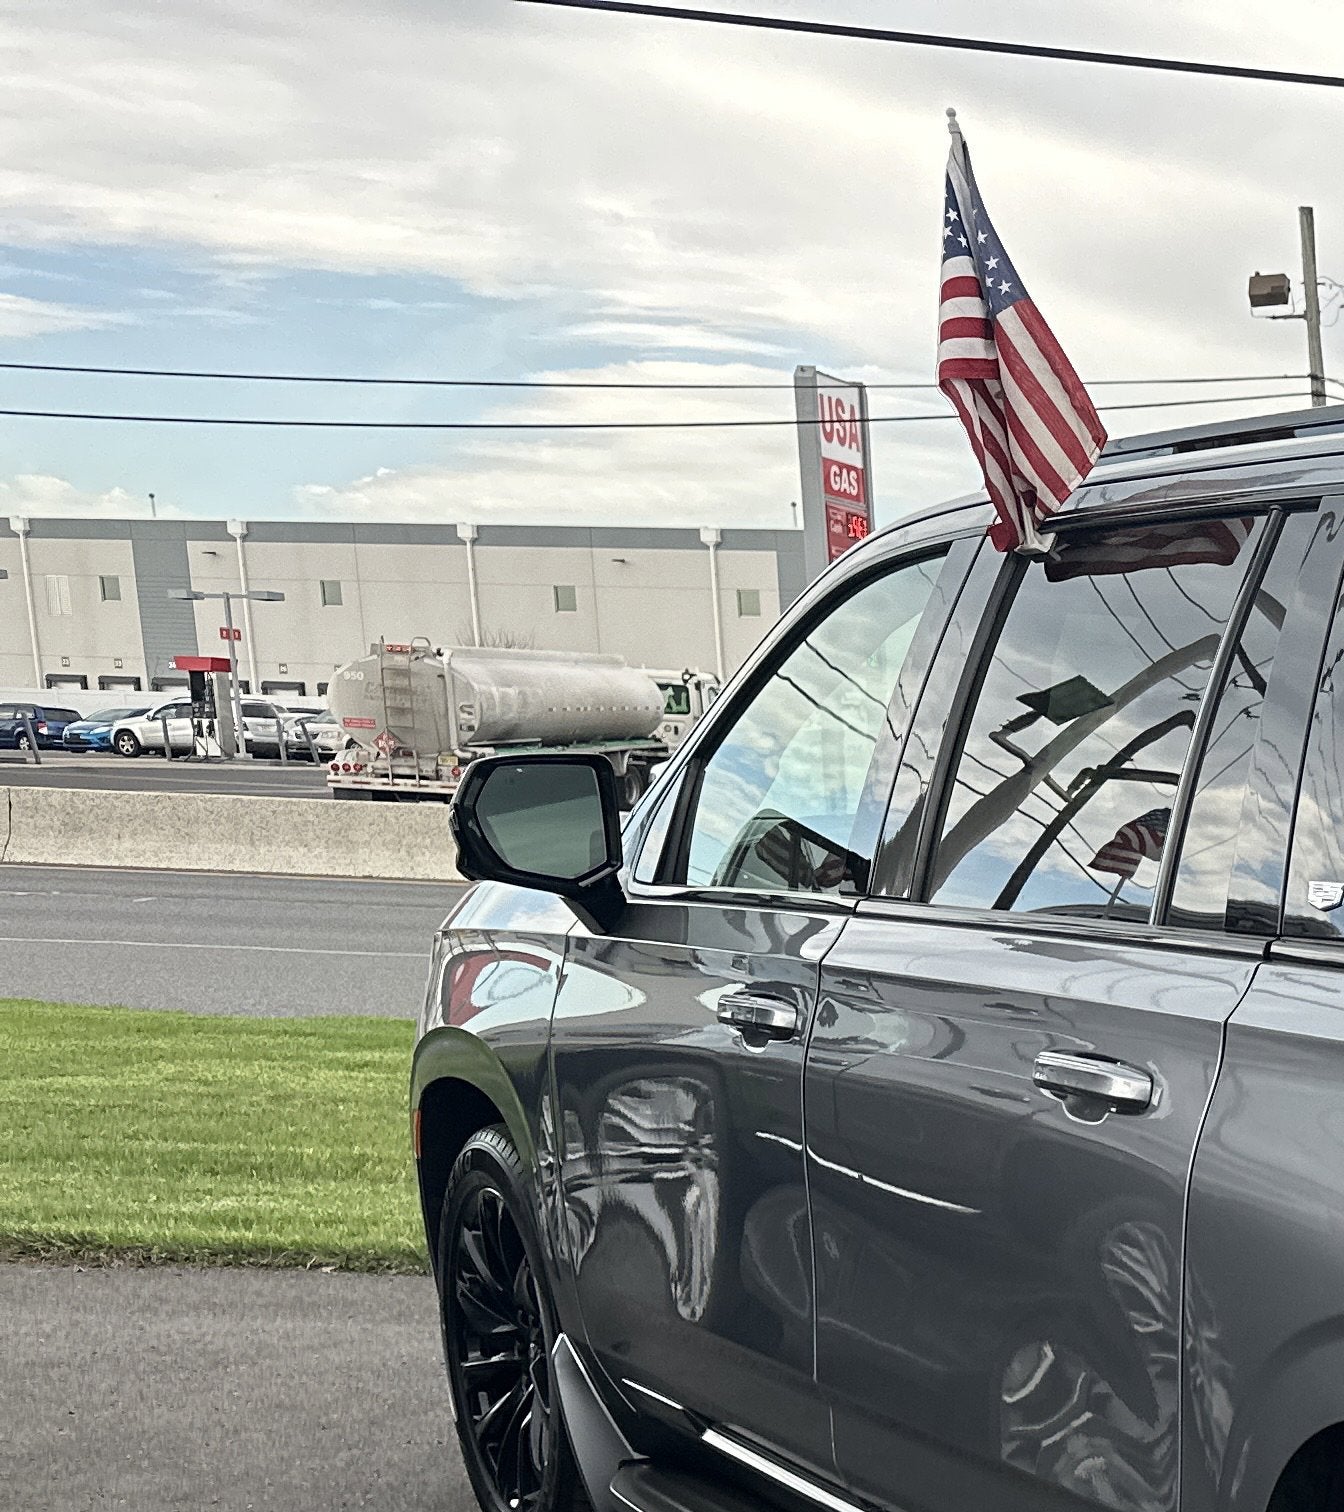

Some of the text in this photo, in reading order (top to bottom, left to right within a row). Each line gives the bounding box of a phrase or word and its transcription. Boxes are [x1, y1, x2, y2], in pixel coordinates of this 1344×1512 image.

[819, 393, 861, 453] USA
[829, 464, 859, 497] GAS
[343, 671, 365, 681] 950
